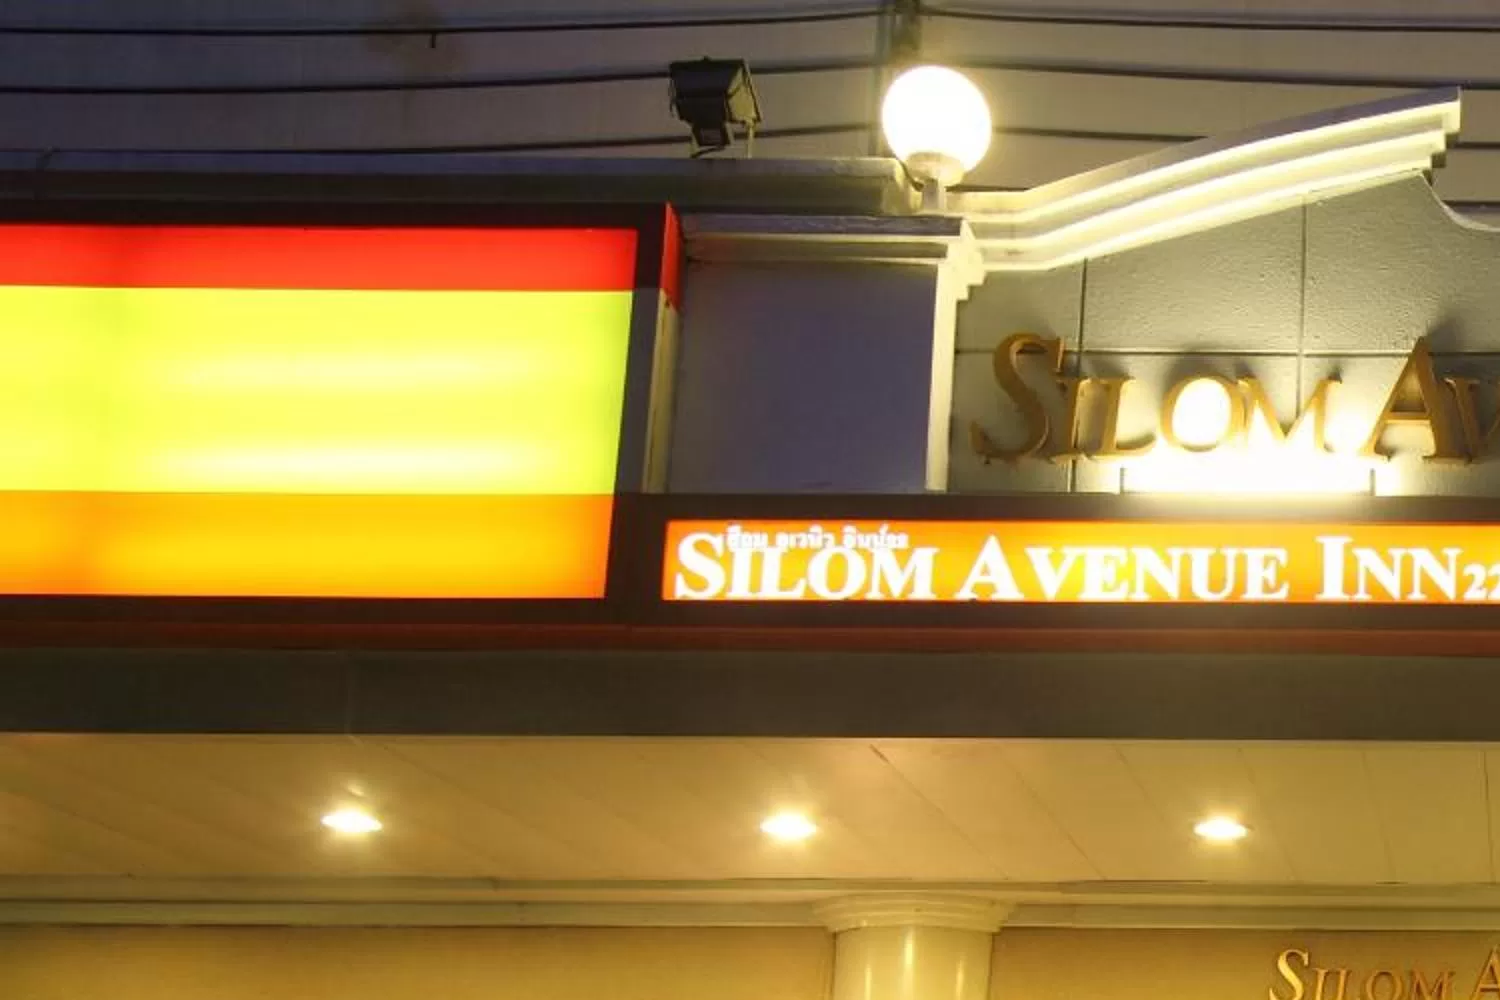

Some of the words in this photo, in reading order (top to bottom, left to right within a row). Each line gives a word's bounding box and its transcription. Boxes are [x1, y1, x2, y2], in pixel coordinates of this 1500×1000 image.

[971, 332, 1343, 463] SILOM
[674, 532, 938, 600] SILOM
[958, 544, 1289, 600] AVENUE
